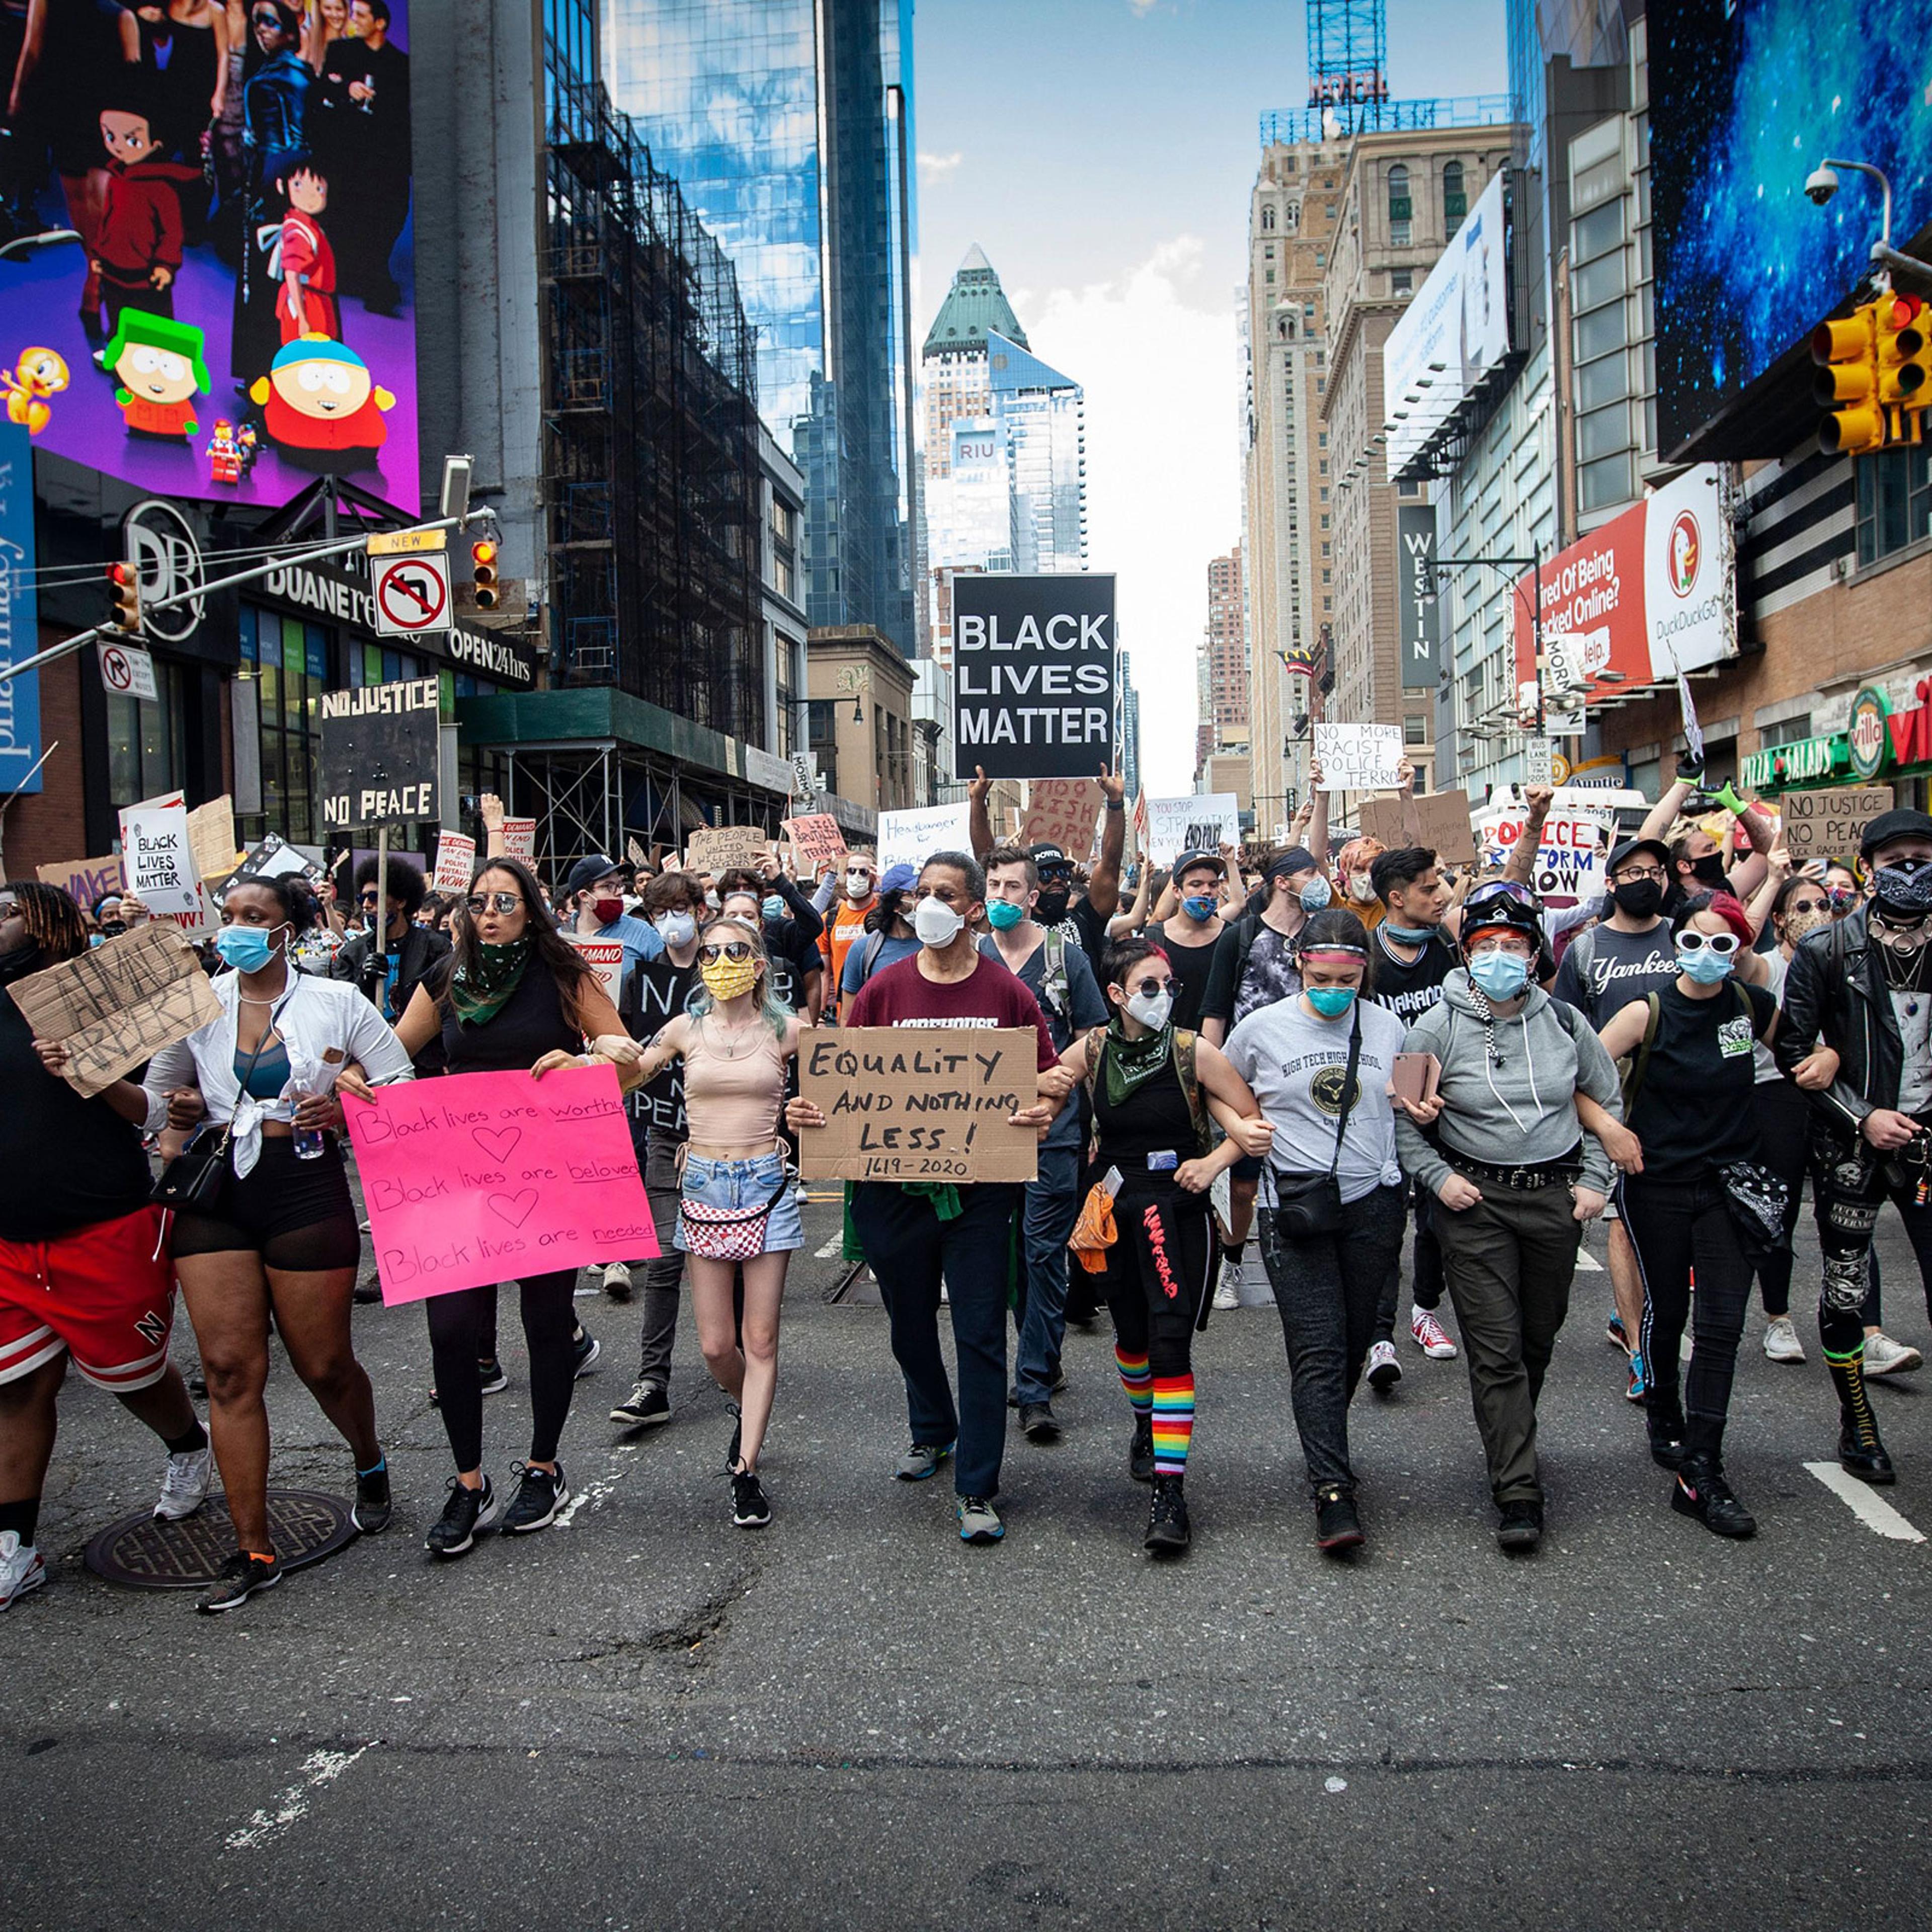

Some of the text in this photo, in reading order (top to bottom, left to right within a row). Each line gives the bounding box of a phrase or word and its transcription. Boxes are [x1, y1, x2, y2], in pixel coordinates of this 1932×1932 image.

[1309, 72, 1388, 99] HOTEL
[960, 444, 994, 459] RIU
[391, 536, 421, 548] NEW
[1535, 549, 1614, 610] ired Of Being
[1404, 532, 1433, 659] WESTIN
[1574, 577, 1620, 626] Online?
[1656, 600, 1719, 640] DuckDuckGo
[958, 614, 1109, 651] BLACK
[959, 664, 1109, 695] LIVES
[322, 679, 437, 719] NO JUSTICE
[960, 707, 1107, 745] MATTER
[1315, 726, 1401, 742] NO MORE
[1851, 716, 1883, 747] villa
[1317, 739, 1384, 758] RACIST
[1532, 741, 1546, 749] BUS
[1319, 755, 1384, 772] POLICE
[1785, 738, 1831, 781] SALADS
[1344, 770, 1401, 787] TERRO
[325, 783, 432, 825] NO PEACE
[1155, 801, 1172, 814] YOU
[1174, 801, 1193, 813] STOP
[1789, 794, 1884, 817] NO JUSTICE
[138, 834, 179, 851] BLACK
[694, 830, 762, 847] THE PEOPLE
[1787, 823, 1813, 844] NO
[1816, 845, 1848, 854] RACIST
[137, 855, 175, 870] LIVES
[444, 858, 467, 869] POLICE
[136, 871, 181, 889] MATTER
[581, 948, 621, 962] EMAND
[1281, 1058, 1302, 1078] HIGH
[1303, 1052, 1326, 1068] TECH
[1326, 1051, 1349, 1064] HIGH
[635, 1089, 687, 1131] PEA
[832, 1090, 1020, 1116] AND NOTHING
[356, 1097, 624, 1144] Black lives are worthy
[865, 1158, 968, 1176] 1619-2020
[370, 1160, 639, 1212] Black lives are beloved
[382, 1223, 654, 1285] Black lives are needed
